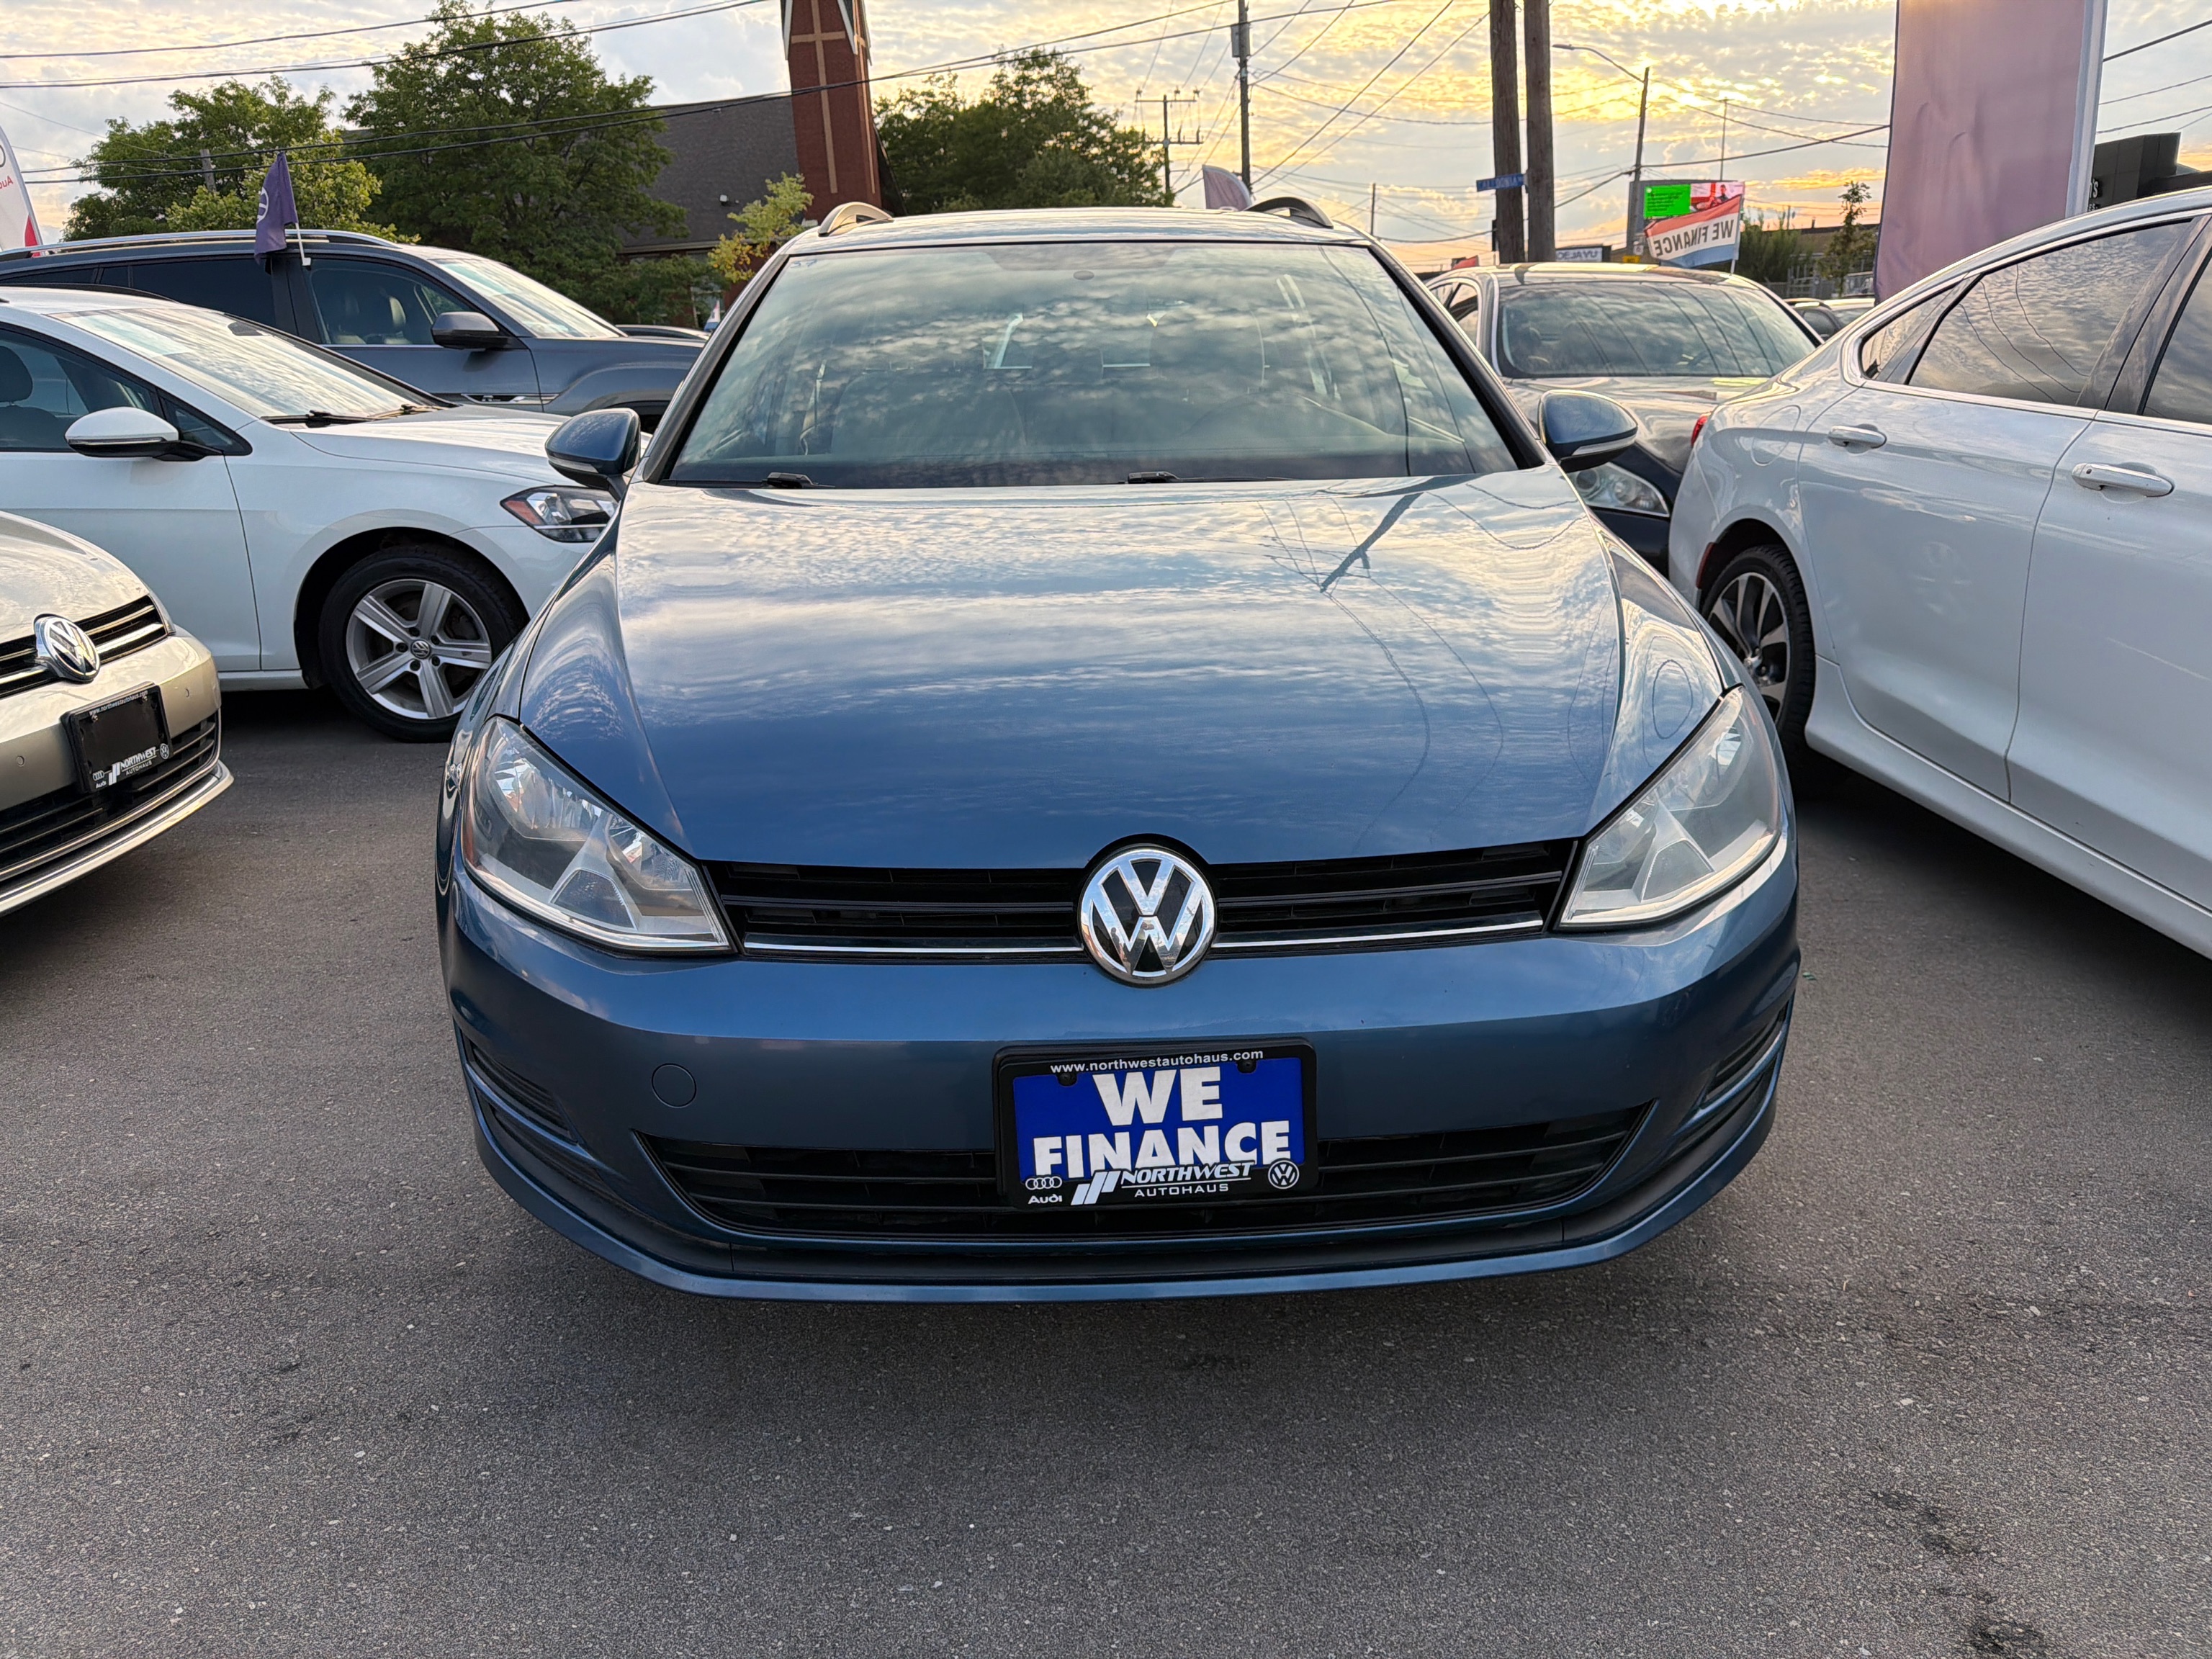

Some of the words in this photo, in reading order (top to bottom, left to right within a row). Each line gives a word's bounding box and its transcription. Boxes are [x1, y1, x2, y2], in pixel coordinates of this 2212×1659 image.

[89, 690, 148, 716] www.northwestautohaus.com
[120, 746, 156, 770] NORTHWEST
[126, 760, 152, 775] AUTOHAUS
[1051, 1050, 1264, 1074] www.northwestautohaus.com
[1092, 1066, 1223, 1126] WE
[1033, 1120, 1291, 1179] FINANCE
[1120, 1161, 1254, 1184] NORTHWEST
[1028, 1194, 1063, 1204] Audi
[1134, 1183, 1228, 1197] AUTOHAUS
